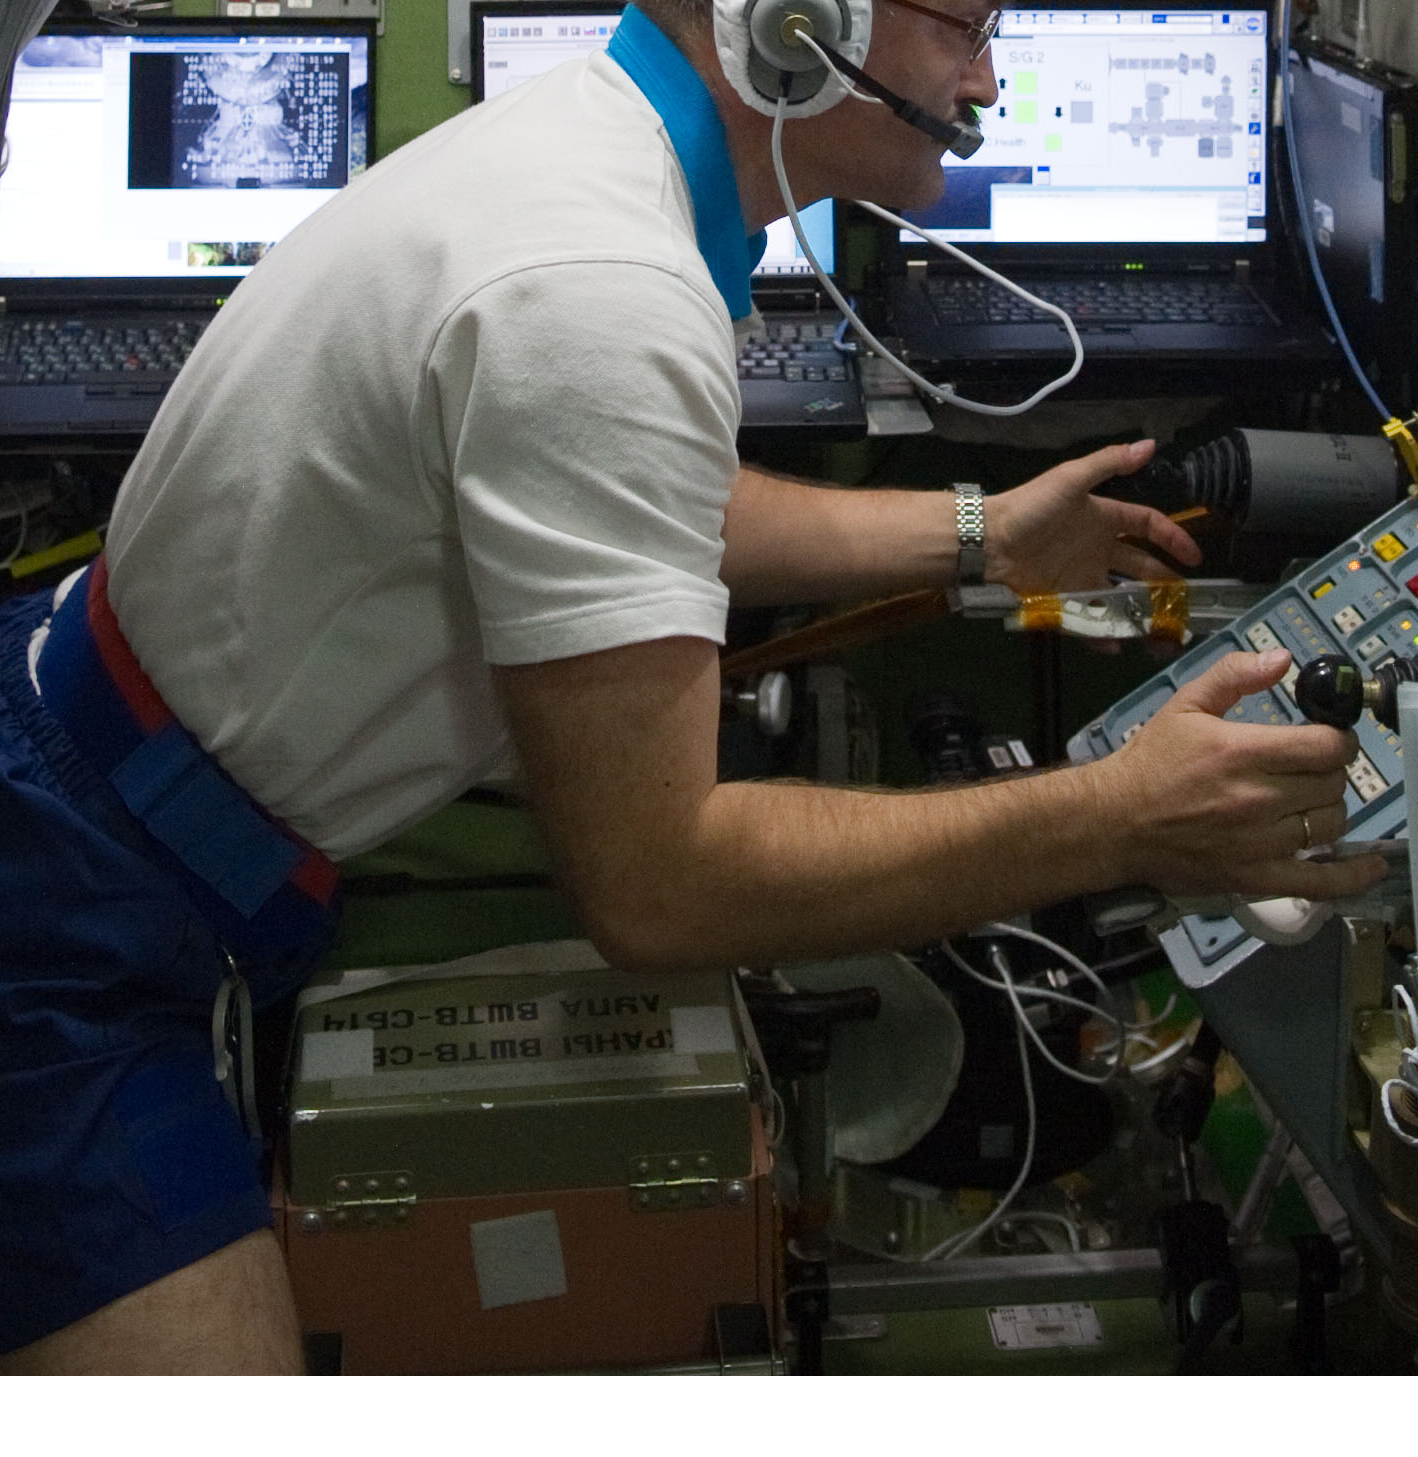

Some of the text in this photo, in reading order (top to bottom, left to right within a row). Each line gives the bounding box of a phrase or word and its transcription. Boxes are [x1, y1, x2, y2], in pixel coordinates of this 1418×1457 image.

[1008, 50, 1045, 64] S/G 2
[1075, 80, 1092, 92] Ku
[563, 993, 661, 1018] ЛУПА
